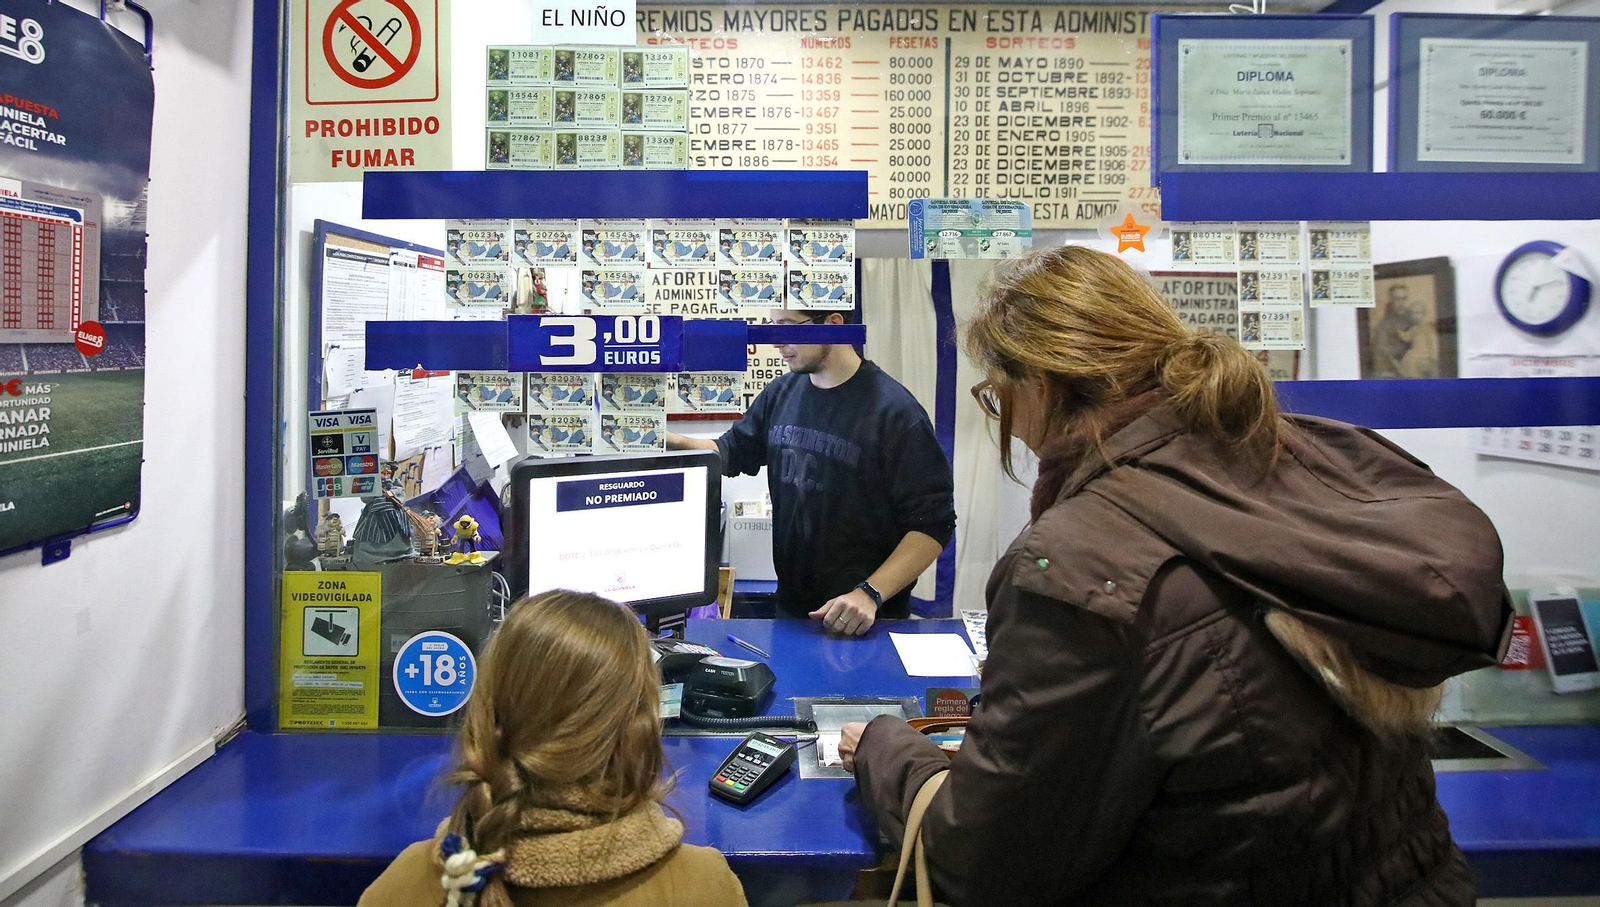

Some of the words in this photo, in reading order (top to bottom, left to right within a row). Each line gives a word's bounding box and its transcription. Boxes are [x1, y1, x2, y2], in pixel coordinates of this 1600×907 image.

[542, 9, 564, 27] EL
[571, 5, 626, 27] NIÑO
[724, 10, 827, 33] MAYORES
[838, 9, 938, 32] PAGADOS
[949, 10, 977, 32] EN
[988, 10, 1042, 32] ESTA
[1055, 10, 1148, 33] ADMINIST
[889, 37, 938, 49] PESETAS
[986, 37, 1076, 50] SORTEOS
[955, 57, 970, 69] 29
[976, 57, 990, 69] DE
[998, 58, 1048, 69] MAYO
[955, 71, 968, 83] 31
[976, 72, 990, 83] DE
[998, 72, 1088, 83] OCTUBRE
[1237, 71, 1294, 82] DIPLOMA
[955, 86, 970, 98] 30
[976, 87, 990, 98] DE
[997, 87, 1098, 98] SEPTIEMBRE
[956, 101, 968, 112] 10
[976, 102, 990, 113] DE
[998, 102, 1053, 113] ABRIL
[954, 116, 969, 127] 23
[975, 116, 990, 127] DE
[998, 116, 1096, 127] DICIEMBRE
[1213, 113, 1240, 122] Primer
[1242, 113, 1271, 122] Premio
[1273, 113, 1281, 122] al
[1294, 113, 1319, 122] 13465
[1, 120, 66, 146] ACERTAR
[305, 116, 440, 138] PROHIBIDO
[954, 131, 970, 142] 20
[975, 130, 990, 142] DE
[998, 131, 1060, 142] ENERO
[953, 145, 969, 156] 23
[975, 145, 990, 156] DE
[997, 146, 1096, 156] DICIEMBRE
[331, 148, 415, 168] FUMAR
[953, 159, 969, 170] 23
[975, 159, 990, 170] DE
[997, 160, 1095, 171] DICIEMBRE
[953, 174, 969, 185] 22
[975, 174, 990, 185] DE
[997, 174, 1094, 185] DICIEMBRE
[952, 188, 967, 199] 31
[975, 188, 990, 199] DE
[996, 187, 1050, 198] JULIO
[1033, 203, 1069, 219] ESTA
[1193, 231, 1222, 239] 88012
[604, 351, 661, 365] EUROS
[767, 358, 787, 367] DEL
[479, 375, 508, 383] 13466
[26, 382, 51, 395] MÁS
[314, 417, 340, 427] VISA
[348, 415, 372, 425] VISA
[624, 417, 653, 425] 12559
[357, 435, 365, 444] V
[600, 480, 645, 491] RESGUARDO
[586, 495, 602, 505] NO
[605, 491, 657, 504] PREMIADO
[318, 581, 347, 590] ZONA
[291, 592, 372, 602] VIDEOVIGILADA
[404, 654, 457, 686] +18
[457, 656, 466, 685] AÑOS
[936, 697, 967, 705] Primera
[956, 704, 969, 712] del
